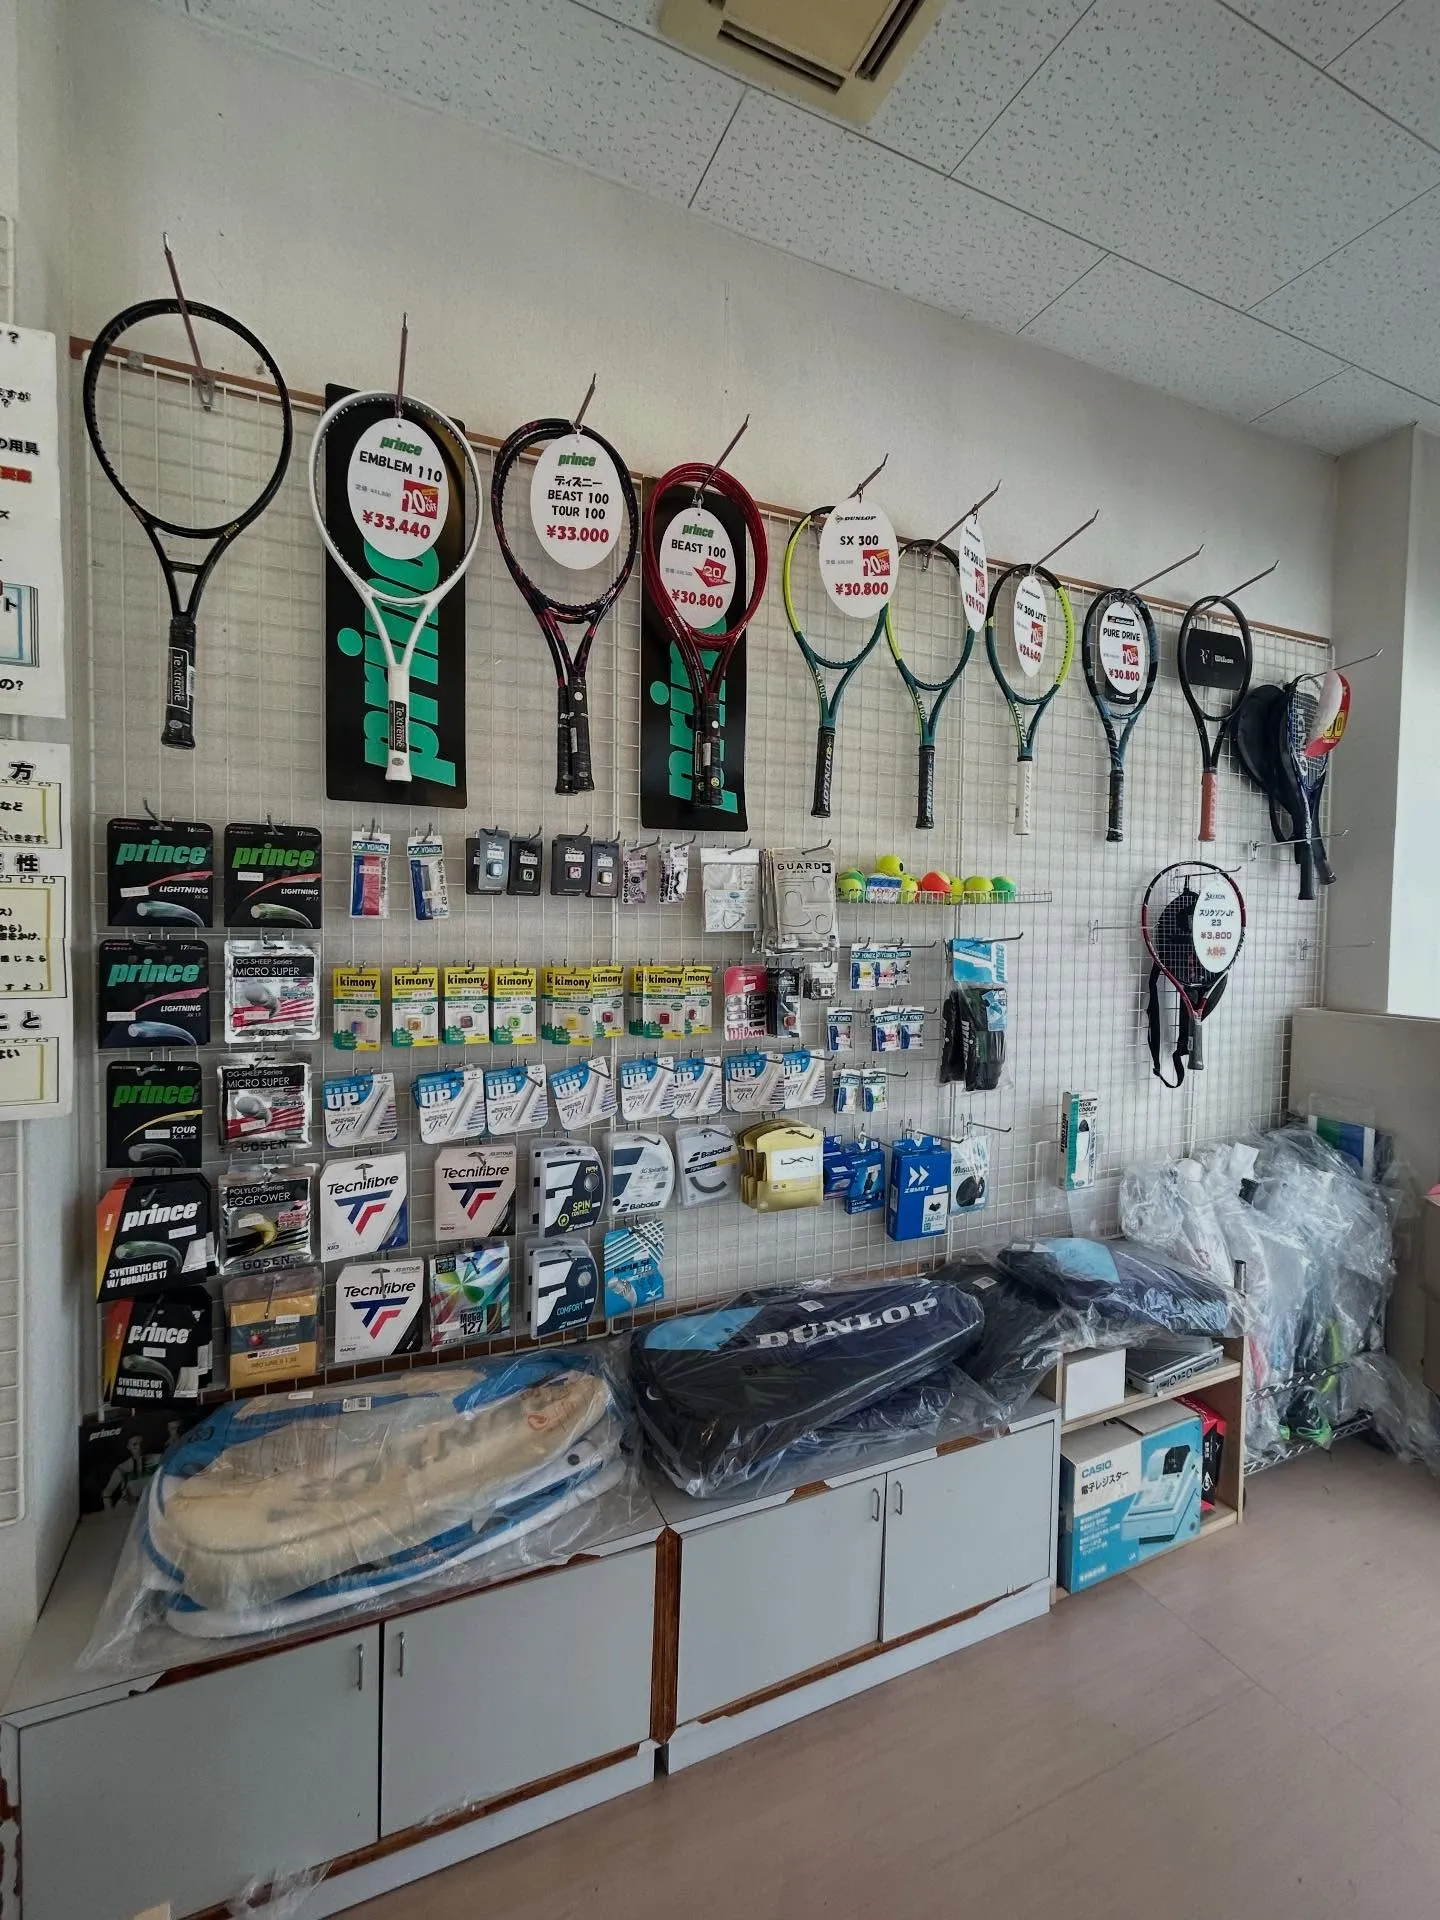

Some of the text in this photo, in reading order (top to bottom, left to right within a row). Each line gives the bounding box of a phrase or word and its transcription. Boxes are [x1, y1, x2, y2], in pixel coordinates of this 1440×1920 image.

[380, 435, 423, 456] prince
[359, 450, 443, 483] EMBLEM 110
[558, 452, 597, 467] prince
[554, 475, 603, 488] ディズニー
[547, 489, 609, 505] BEAST 100
[551, 504, 606, 520] TOUR 100
[681, 523, 715, 539] prince
[840, 535, 879, 546] SX 300
[671, 539, 727, 559] BEAST 100
[703, 565, 722, 579] 20
[1024, 605, 1035, 617] 300
[1103, 627, 1141, 641] PURE DRIVE
[1214, 654, 1234, 664] Wilson
[10, 761, 34, 781] 方
[822, 751, 832, 812] DUNLOP
[116, 839, 207, 865] prince
[367, 843, 388, 851] YONEX
[232, 843, 315, 868] prince
[17, 855, 38, 872] 性
[777, 863, 821, 871] GUARD
[159, 886, 208, 894] LIGHTNING
[1211, 919, 1222, 927] 23
[107, 959, 199, 986] prince
[235, 967, 300, 976] MICRO SUPER
[340, 978, 376, 989] kimony
[395, 975, 434, 987] kimony
[448, 975, 485, 986] kimony
[497, 976, 533, 987] kimony
[555, 976, 590, 988] kimony
[593, 974, 621, 984] kimony
[649, 975, 682, 986] kimony
[685, 974, 710, 985] imony
[227, 1069, 261, 1078] OG-SHEEP
[226, 1076, 290, 1088] MICRO SUPER
[112, 1080, 194, 1108] prince
[172, 1126, 196, 1134] TOUR
[241, 1141, 289, 1152] GOSEN
[701, 1144, 733, 1158] Babolat
[441, 1165, 510, 1179] Tecnifibre
[327, 1175, 399, 1196] Tecnifibre
[229, 1192, 291, 1206] EGGPOWER
[572, 1200, 591, 1212] SPIN
[630, 1201, 661, 1210] Babolat
[122, 1202, 199, 1232] prince
[109, 1260, 168, 1277] SYNTHETIC GUT
[243, 1255, 291, 1269] GOSEN
[107, 1271, 167, 1289] W/ DURAFLEX 17
[343, 1281, 415, 1298] Tecnifibre
[557, 1303, 584, 1315] COMFORT
[460, 1320, 483, 1335] 127
[756, 1297, 938, 1349] DUNLOP
[128, 1322, 189, 1344] prince
[118, 1377, 163, 1389] SYNTHETIC GUT
[126, 1388, 155, 1398] DURAFLEX
[156, 1390, 163, 1398] 18
[89, 1426, 122, 1441] prince
[1082, 1459, 1112, 1478] CASIO
[1081, 1471, 1129, 1495] 電子レジスター
